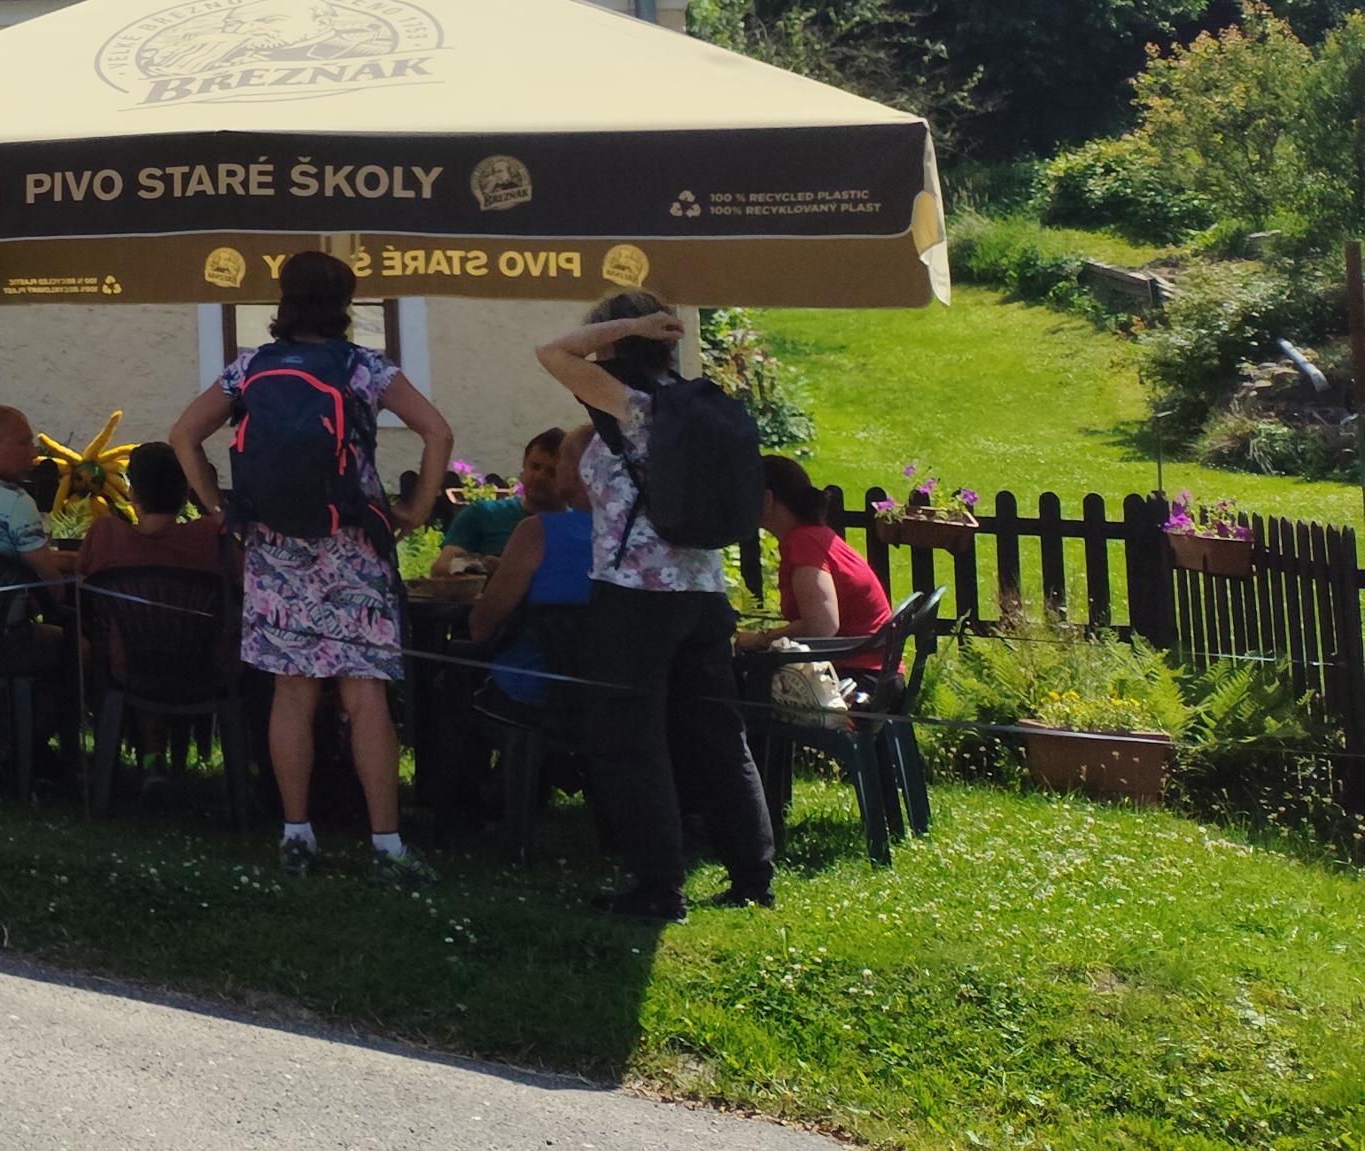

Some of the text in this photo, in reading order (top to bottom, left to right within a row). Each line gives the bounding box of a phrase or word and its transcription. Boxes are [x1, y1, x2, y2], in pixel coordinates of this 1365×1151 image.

[136, 56, 435, 105] BŘEZŇÁK
[25, 155, 444, 204] PIVO STARÉ ŠKOLY
[709, 202, 882, 215] 100% RECYKLOVANÝ PLAST
[710, 190, 869, 202] 100 % RECYCLED PLASTIC
